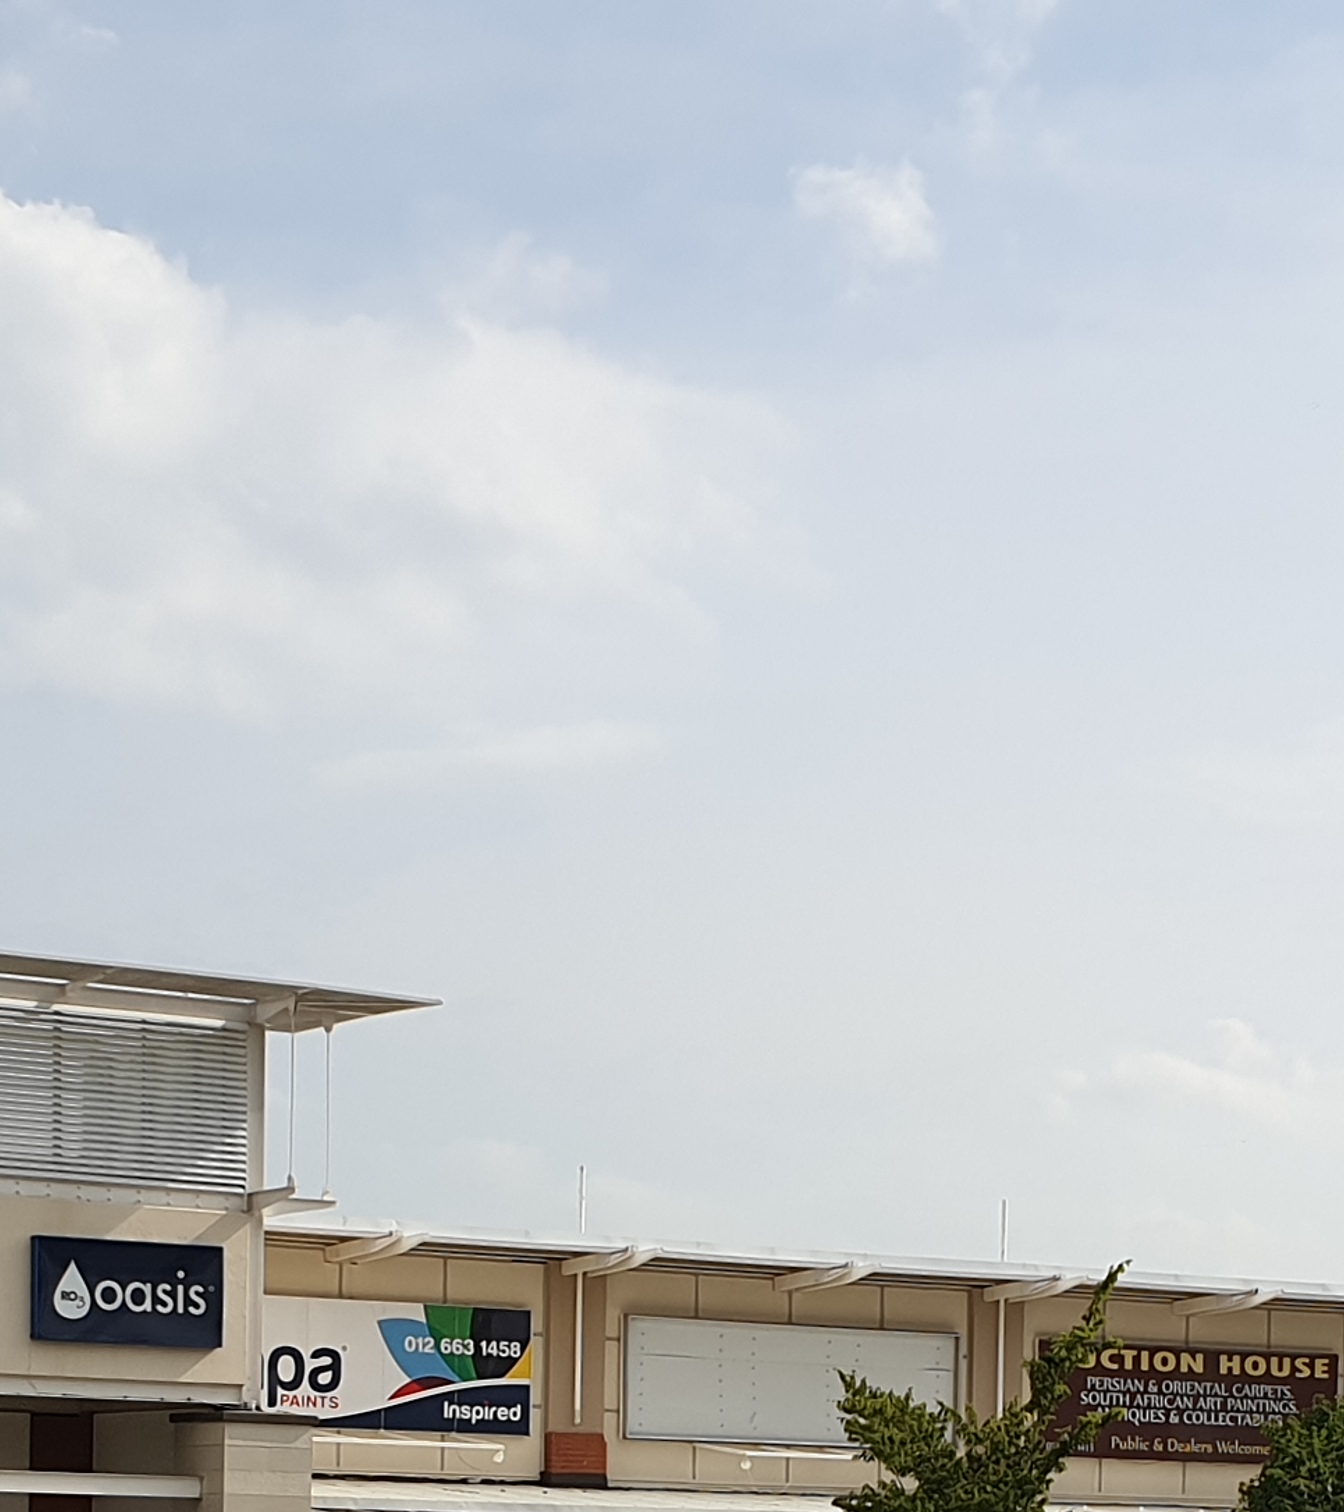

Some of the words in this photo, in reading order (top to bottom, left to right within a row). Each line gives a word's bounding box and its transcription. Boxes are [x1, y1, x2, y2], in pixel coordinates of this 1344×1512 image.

[94, 1269, 208, 1316] oasis
[404, 1335, 436, 1354] 012
[440, 1338, 475, 1356] 663
[479, 1340, 522, 1358] 1458
[260, 1345, 342, 1408] pa
[1219, 1354, 1330, 1379] HOUSE
[1087, 1376, 1144, 1392] PERSIAN
[1147, 1380, 1158, 1392] &
[1162, 1380, 1229, 1396] ORIENTAL
[279, 1393, 340, 1409] PAINTS
[1080, 1391, 1130, 1405] SOUTH
[1133, 1394, 1194, 1409] AFRICAN
[1196, 1396, 1223, 1410] ART
[443, 1401, 522, 1424] Inspired
[1169, 1410, 1180, 1424] &
[1111, 1436, 1149, 1450] Public
[1153, 1438, 1164, 1452] &
[1167, 1438, 1213, 1453] Dealers
[1216, 1440, 1272, 1455] Welcome
